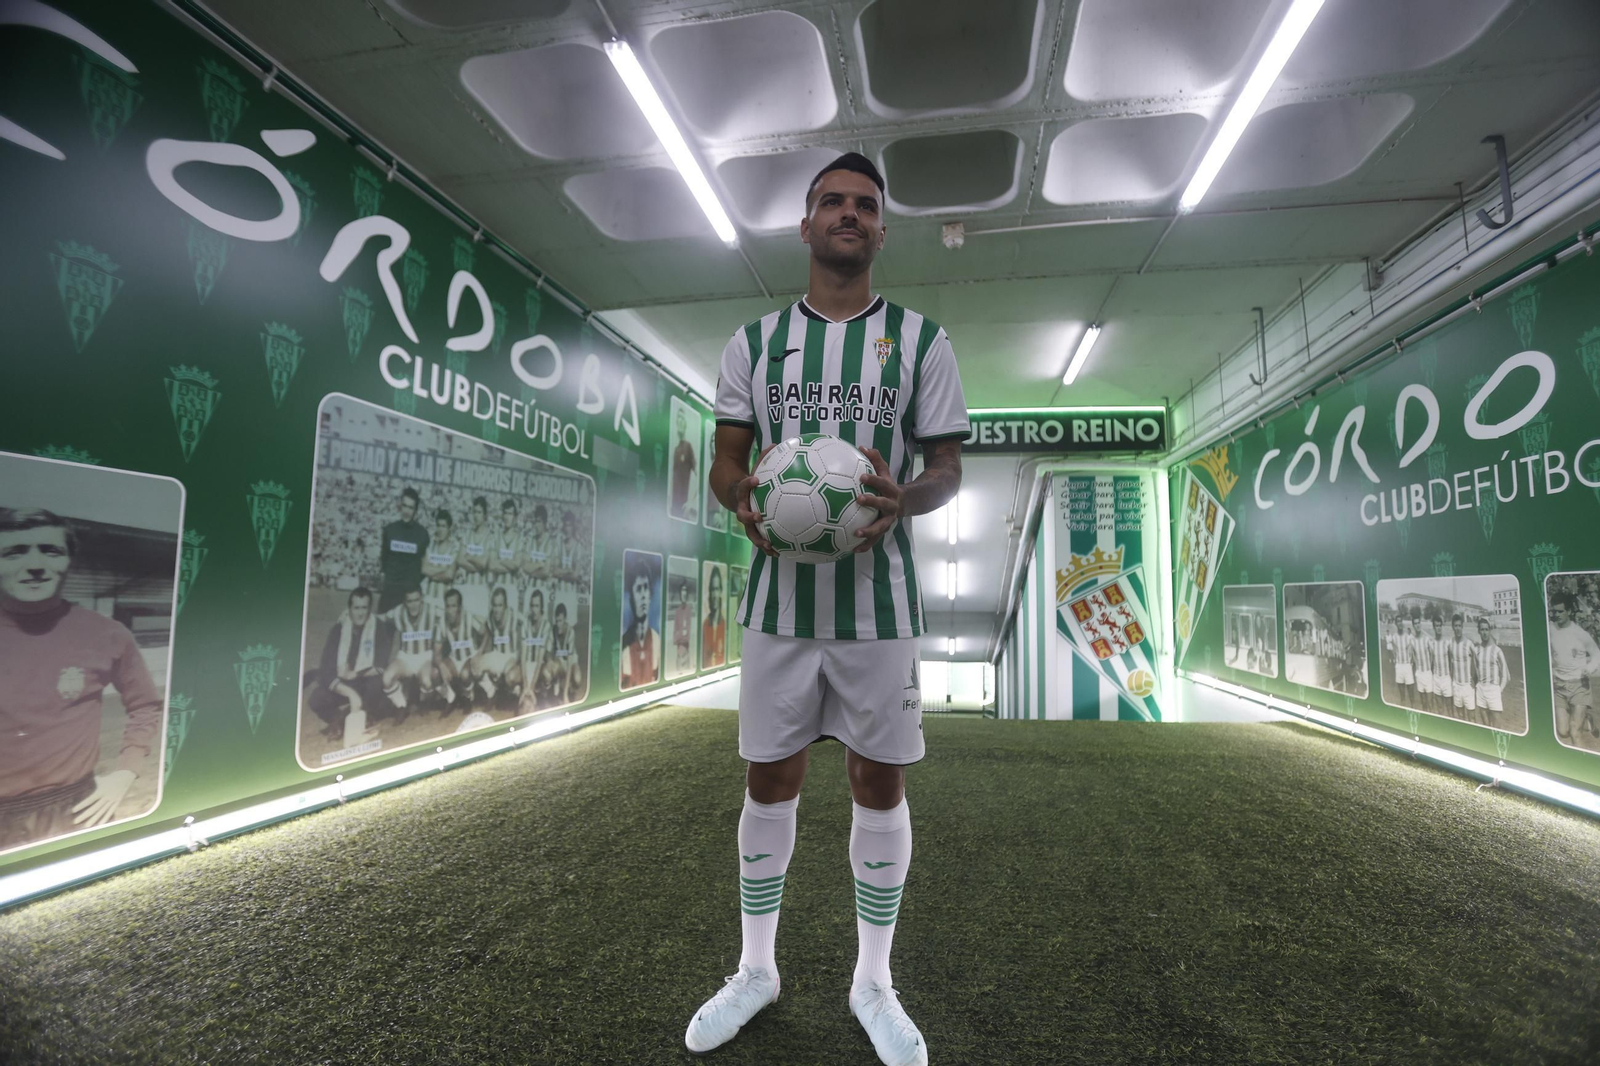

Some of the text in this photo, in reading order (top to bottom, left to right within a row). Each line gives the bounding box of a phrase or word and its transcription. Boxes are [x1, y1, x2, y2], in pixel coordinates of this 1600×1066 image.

[768, 383, 898, 410] BAHRAIN
[962, 417, 1161, 445] UESTRO REINO
[329, 439, 386, 474] PIEDAD
[387, 448, 398, 476] Y
[398, 449, 434, 481] CAJA
[435, 457, 453, 484] DE
[453, 460, 511, 493] AHORROS
[511, 470, 527, 495] DE
[527, 473, 579, 502] CORDOBA
[1061, 480, 1146, 491] Jugar para ganar
[1060, 490, 1147, 501] Ganar para sentir
[1060, 500, 1148, 511] Sentir para luchar
[1063, 511, 1146, 522] Luchar para vivir
[1065, 522, 1090, 531] Vivir
[1090, 523, 1114, 534] para
